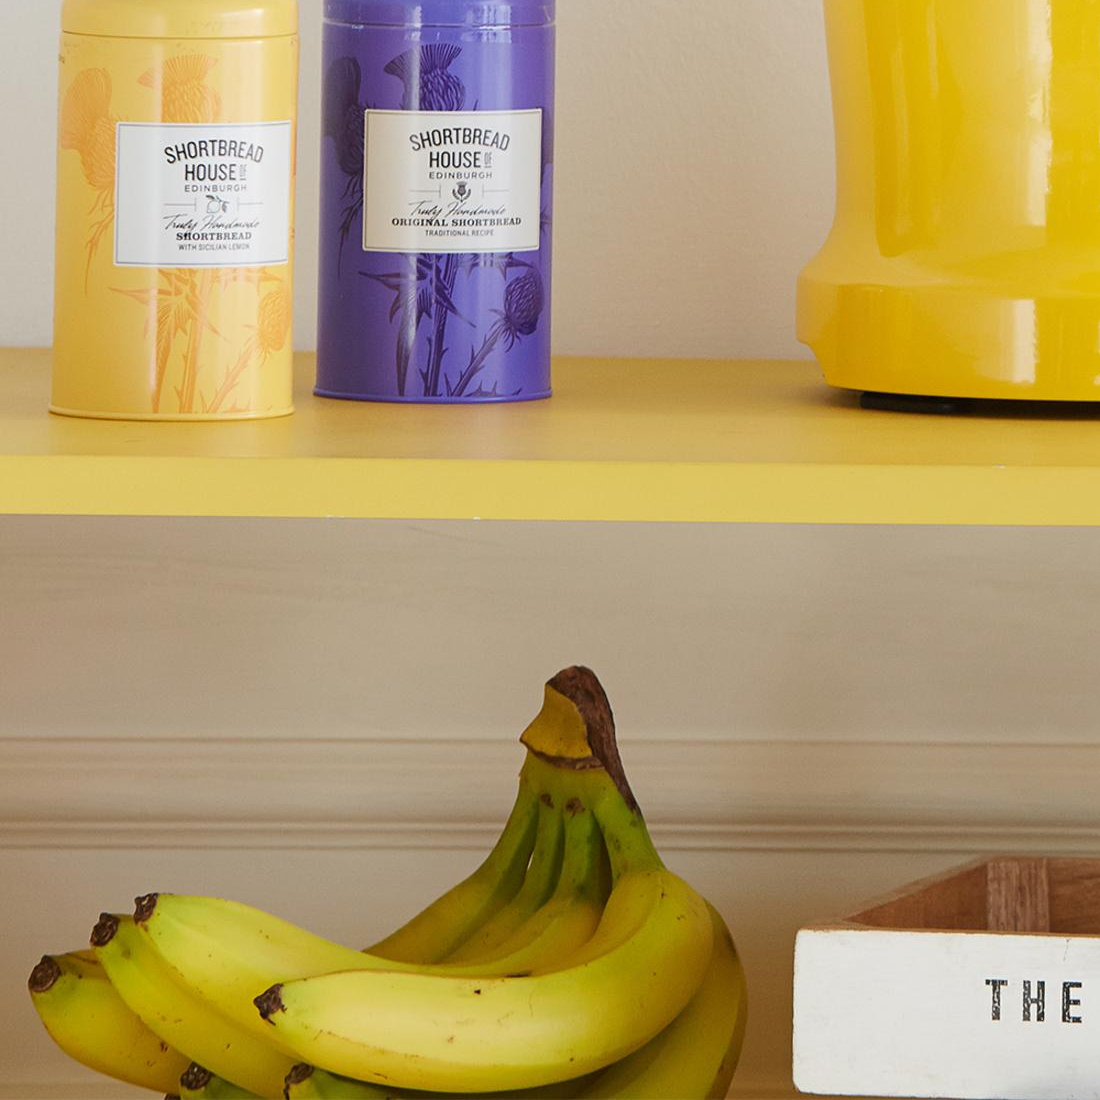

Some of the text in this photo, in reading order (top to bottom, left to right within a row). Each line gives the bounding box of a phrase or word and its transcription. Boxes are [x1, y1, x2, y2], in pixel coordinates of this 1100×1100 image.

[409, 127, 511, 152] SHORTBREAD
[164, 139, 264, 164] SHORTBREAD
[429, 151, 481, 168] HOUSE
[184, 163, 236, 181] HOUSE
[429, 171, 492, 180] EDINBURGH
[184, 184, 247, 193] EDINBURGH
[408, 200, 444, 222] Truly
[163, 213, 199, 232] Truly
[391, 217, 522, 227] ORIGINAL SHORTBREAD
[176, 231, 252, 241] SHORTBREAD
[425, 229, 494, 237] TRADITIONAL RECIPE
[178, 243, 197, 251] WITH
[198, 243, 227, 251] SICILIAN
[984, 978, 1083, 1024] THE
